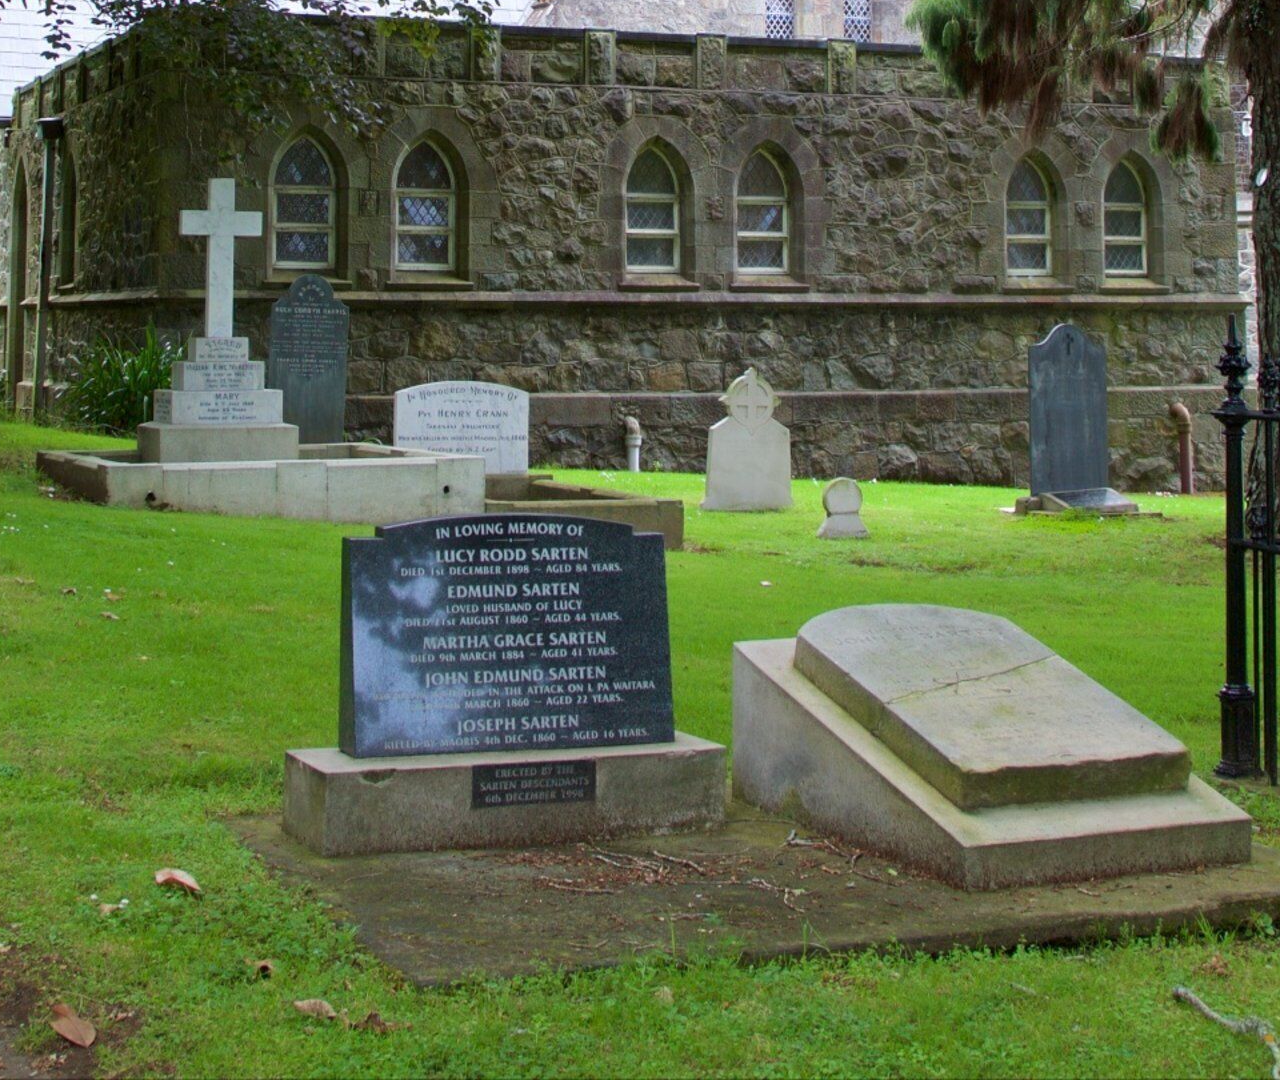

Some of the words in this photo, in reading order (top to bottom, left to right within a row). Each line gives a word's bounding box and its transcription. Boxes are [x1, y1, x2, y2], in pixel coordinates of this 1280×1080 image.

[470, 386, 505, 398] MEMORY
[437, 410, 472, 418] HENRY
[475, 409, 509, 418] CRANN
[436, 528, 450, 539] IN
[455, 525, 504, 538] LOVING
[508, 523, 563, 537] MEMORY
[567, 525, 585, 537] OF
[436, 549, 476, 563] LUCY
[480, 548, 527, 562] RODD
[532, 547, 589, 561] SARTEN
[401, 568, 425, 577] DIED
[430, 568, 446, 576] 1st
[449, 566, 502, 576] DECEMBER
[506, 565, 530, 575] 1898
[546, 564, 572, 573] AGED
[575, 564, 587, 573] 84
[591, 563, 623, 572] YEARS.
[447, 583, 518, 598] EDMUND
[522, 582, 580, 597] SARTEN
[446, 604, 479, 614] LOVED
[483, 603, 532, 613] HUSBAND
[535, 602, 549, 612] OF
[553, 600, 583, 611] LUCY
[405, 618, 431, 628] DIED
[459, 615, 501, 626] AUGUST
[505, 614, 529, 624] 1860
[544, 613, 571, 623] AGED
[574, 613, 587, 622] 44
[591, 611, 622, 621] YEARS.
[423, 634, 489, 650] MARTHA
[494, 632, 544, 647] GRACE
[548, 631, 607, 645] SARTEN
[410, 654, 435, 663] DIED
[439, 653, 456, 662] 9th
[460, 651, 497, 661] MARCH
[501, 650, 525, 660] 1884
[541, 649, 567, 658] AGED
[571, 648, 583, 657] 41
[587, 647, 619, 656] YEARS.
[424, 671, 469, 688] JOHN
[474, 668, 545, 684] EDMUND
[548, 666, 607, 680] SARTEN
[488, 688, 500, 697] IN
[504, 686, 523, 696] THE
[527, 685, 564, 695] ATTACK
[568, 683, 584, 693] ON
[597, 682, 610, 691] PA
[613, 680, 656, 691] WAITARA
[464, 699, 501, 709] MARCH
[506, 698, 530, 707] 1860
[546, 696, 573, 706] AGED
[577, 695, 589, 704] 22
[592, 694, 624, 704] YEARS.
[457, 717, 516, 735] JOSEPH
[521, 715, 580, 729] SARTEN
[440, 736, 480, 747] MAORIS
[484, 735, 501, 745] 4th
[504, 734, 528, 744] DEC.
[532, 733, 556, 743] 1860
[572, 731, 599, 740] AGED
[603, 729, 615, 739] 16
[618, 728, 650, 737] YEARS.
[495, 767, 537, 778] ERECTED
[541, 766, 553, 775] BY
[557, 764, 575, 774] THE
[480, 780, 517, 791] SARTEN
[520, 777, 590, 788] DESCENDANTS
[505, 791, 557, 802] DECEMBER
